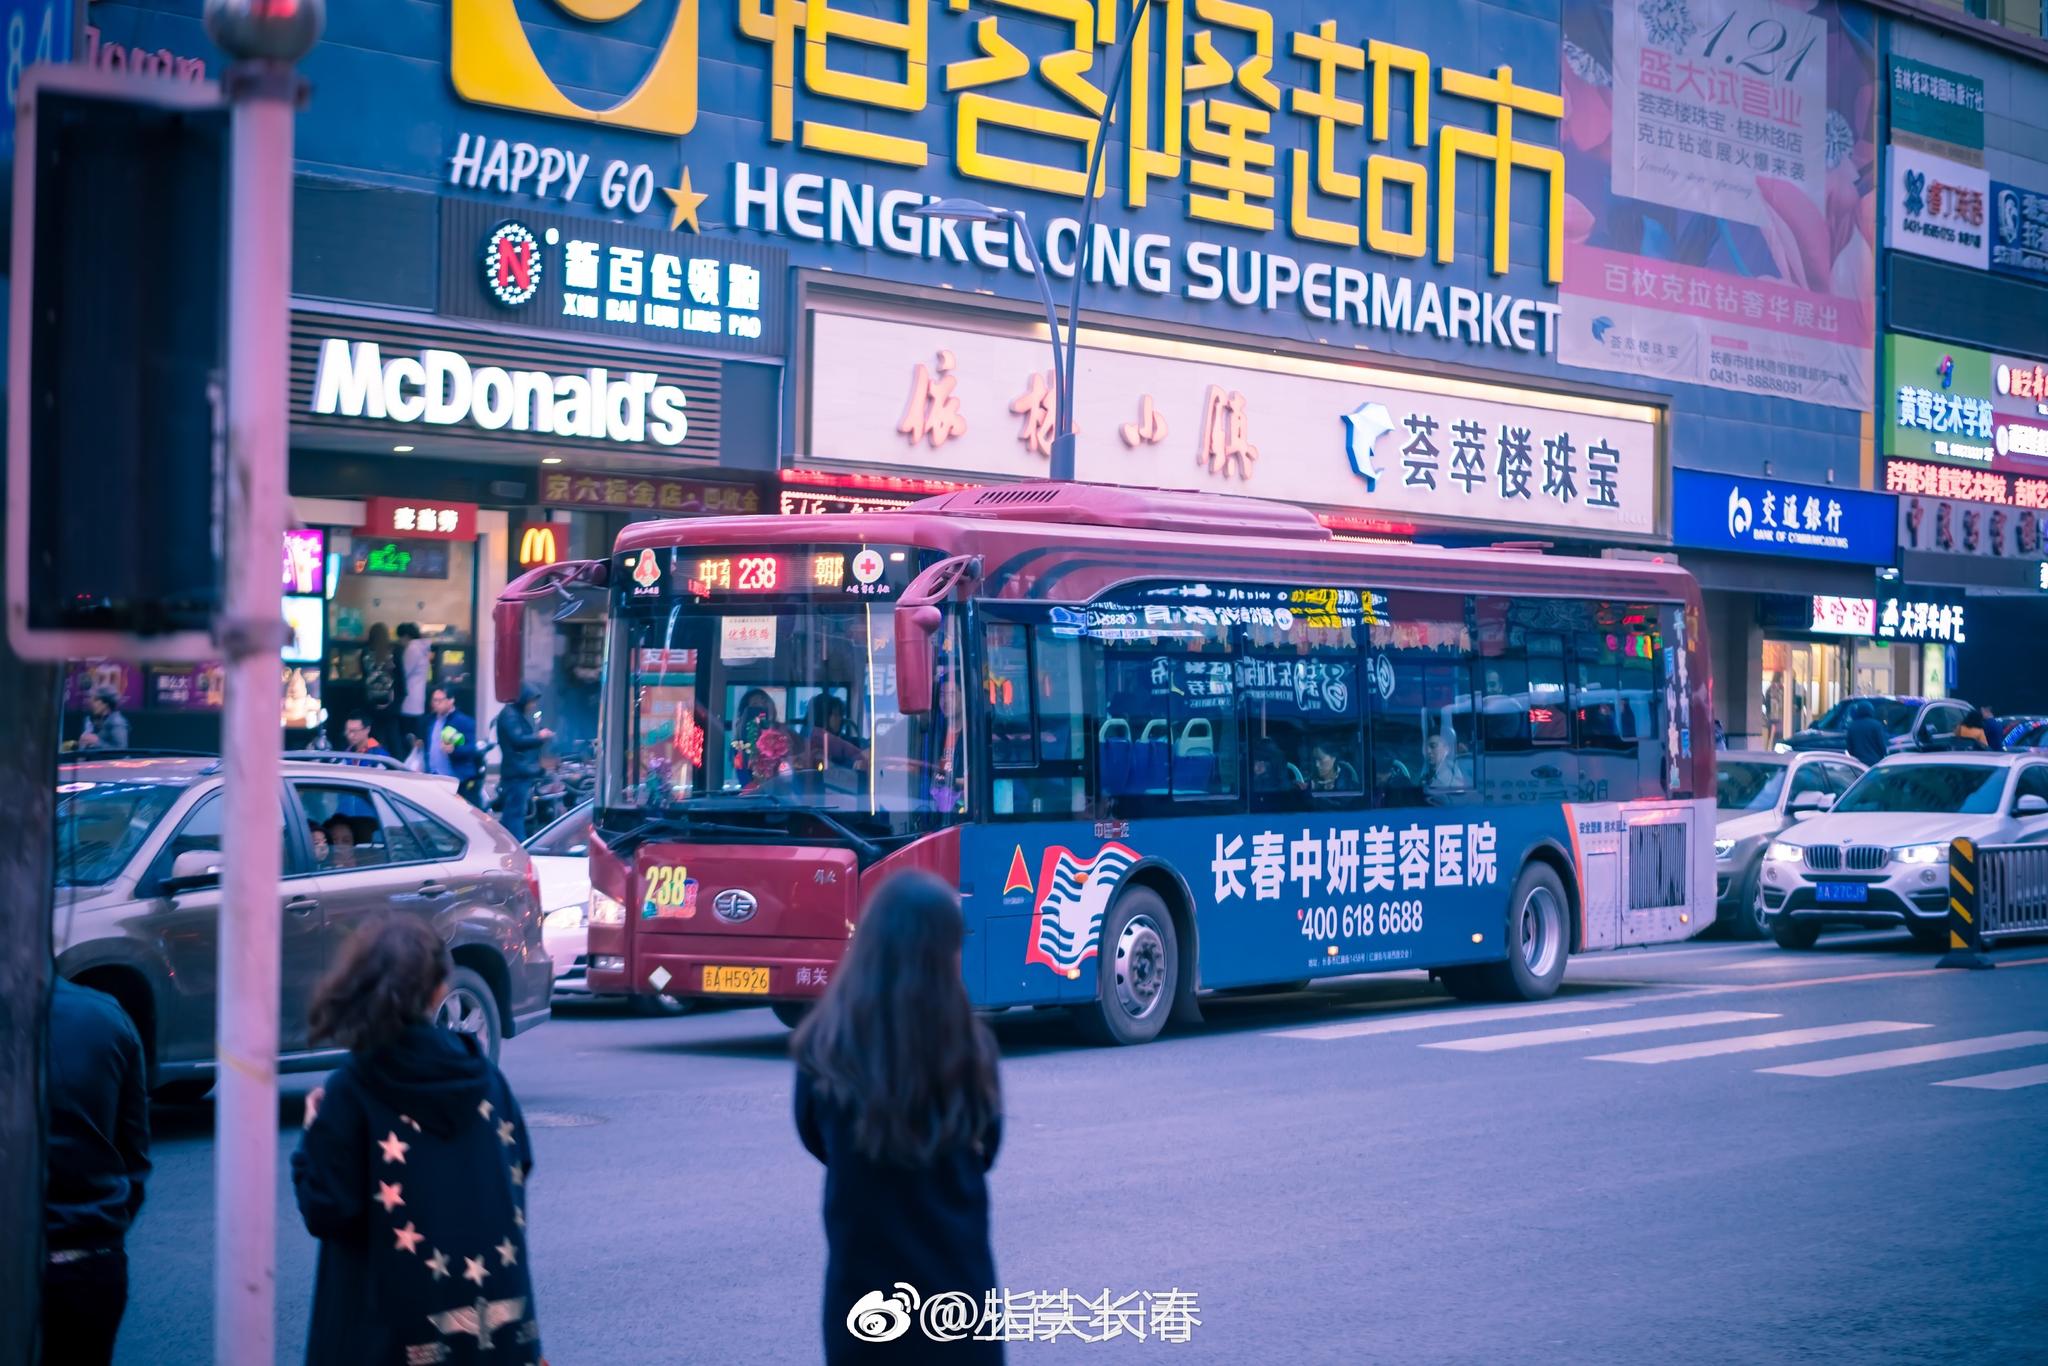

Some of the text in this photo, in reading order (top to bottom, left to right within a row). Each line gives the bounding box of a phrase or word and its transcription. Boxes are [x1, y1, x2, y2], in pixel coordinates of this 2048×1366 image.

[1701, 10, 1817, 83] 1.21
[1639, 47, 1803, 129] 盛大试营业
[451, 132, 655, 214] HAPPY GO
[733, 162, 1563, 354] HENGKELONG SUPERMARKET
[1602, 262, 1840, 333] 百枚克拉钻奢华展出
[316, 337, 688, 446] McDonald's
[1899, 385, 1994, 439] 黄莺艺术学校
[1400, 413, 1621, 508] 荟萃楼珠宝
[1753, 528, 1774, 542] BANK
[1776, 530, 1787, 543] OF
[738, 557, 777, 589] 238
[645, 865, 688, 906] 238
[1210, 820, 1498, 904] 长春中妍美容医院
[1301, 900, 1423, 941] 400 618 6688
[796, 966, 829, 986] 南关
